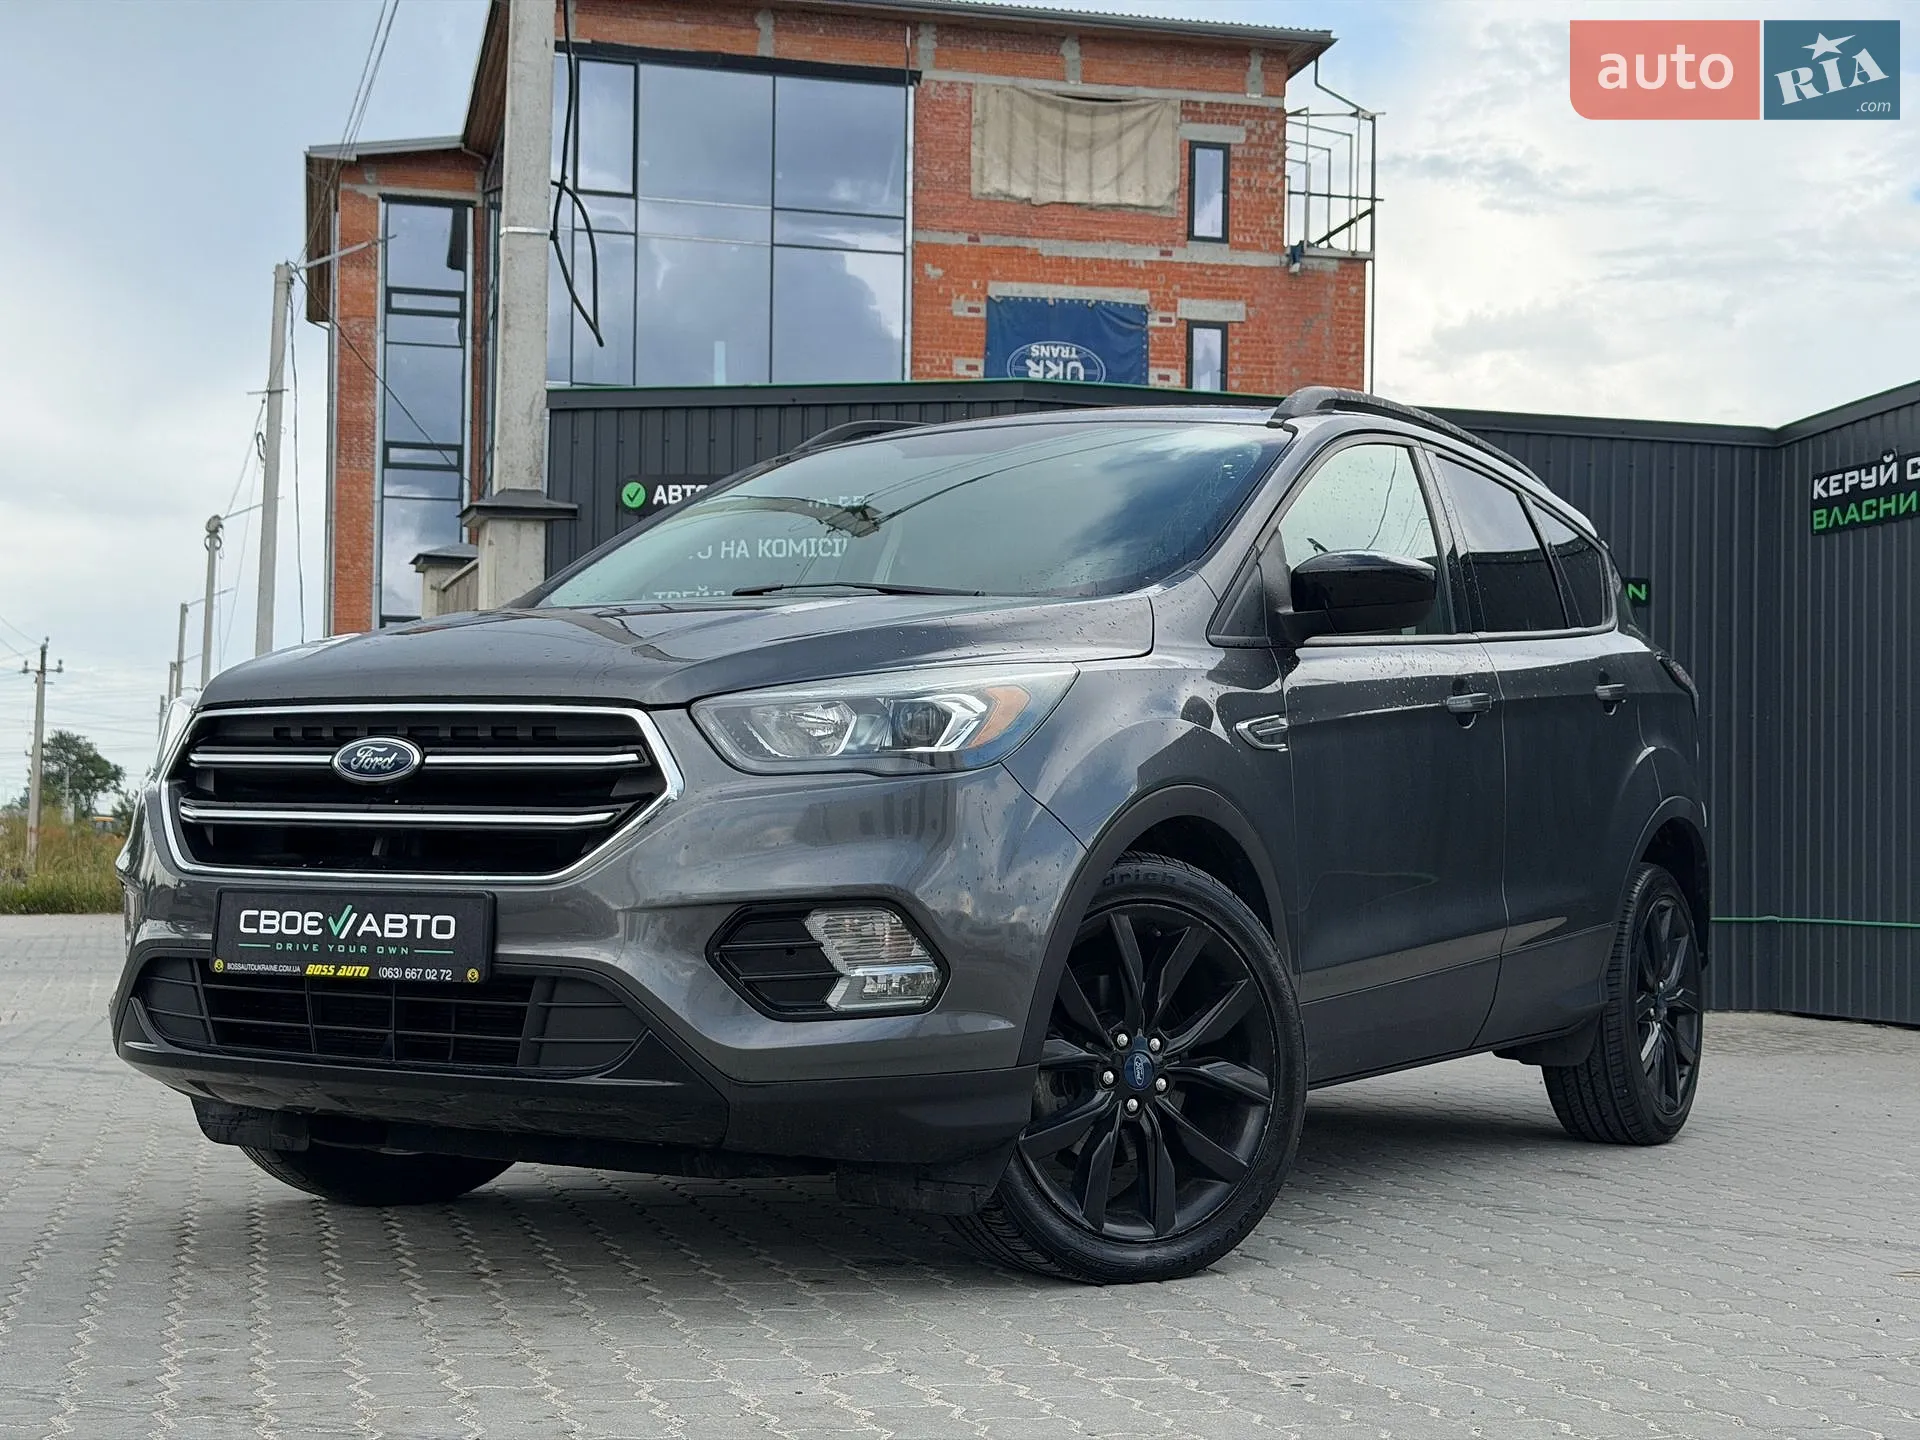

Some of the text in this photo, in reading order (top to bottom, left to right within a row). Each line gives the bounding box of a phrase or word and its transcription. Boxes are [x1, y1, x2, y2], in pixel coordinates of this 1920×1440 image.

[1030, 344, 1079, 359] TRANS
[1025, 359, 1085, 381] UKR
[1813, 453, 1898, 500] КЕРУЙ
[1812, 490, 1918, 531] ВЛАСНИ
[758, 537, 848, 559] КОМІСІ
[350, 745, 398, 770] Ford
[356, 912, 456, 940] АВТО
[275, 942, 410, 955] DRIVE YOUR OWN
[305, 964, 335, 975] BOSS
[336, 965, 370, 977] AUTO
[378, 966, 403, 979] (063)
[404, 968, 423, 979] 667
[424, 968, 438, 980] 02
[439, 968, 452, 981] 72
